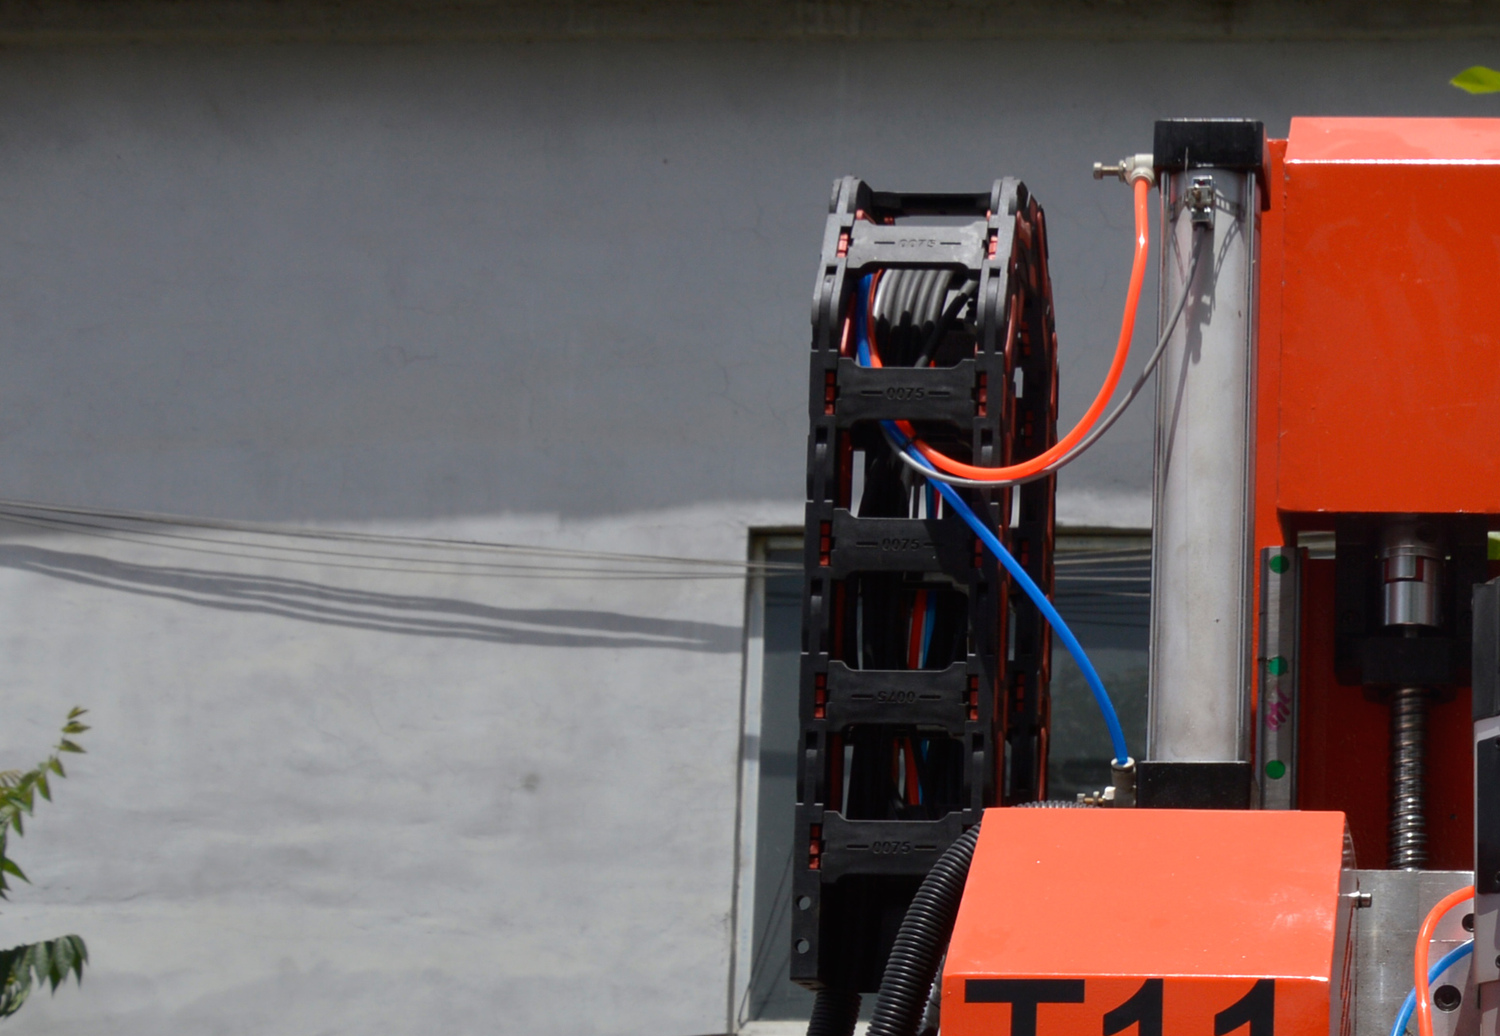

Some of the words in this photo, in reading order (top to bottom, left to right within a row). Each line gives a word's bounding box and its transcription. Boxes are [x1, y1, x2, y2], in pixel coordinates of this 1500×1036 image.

[886, 386, 925, 400] 0075
[882, 537, 920, 551] 0075
[878, 691, 916, 703] 0075
[872, 841, 911, 854] 0075
